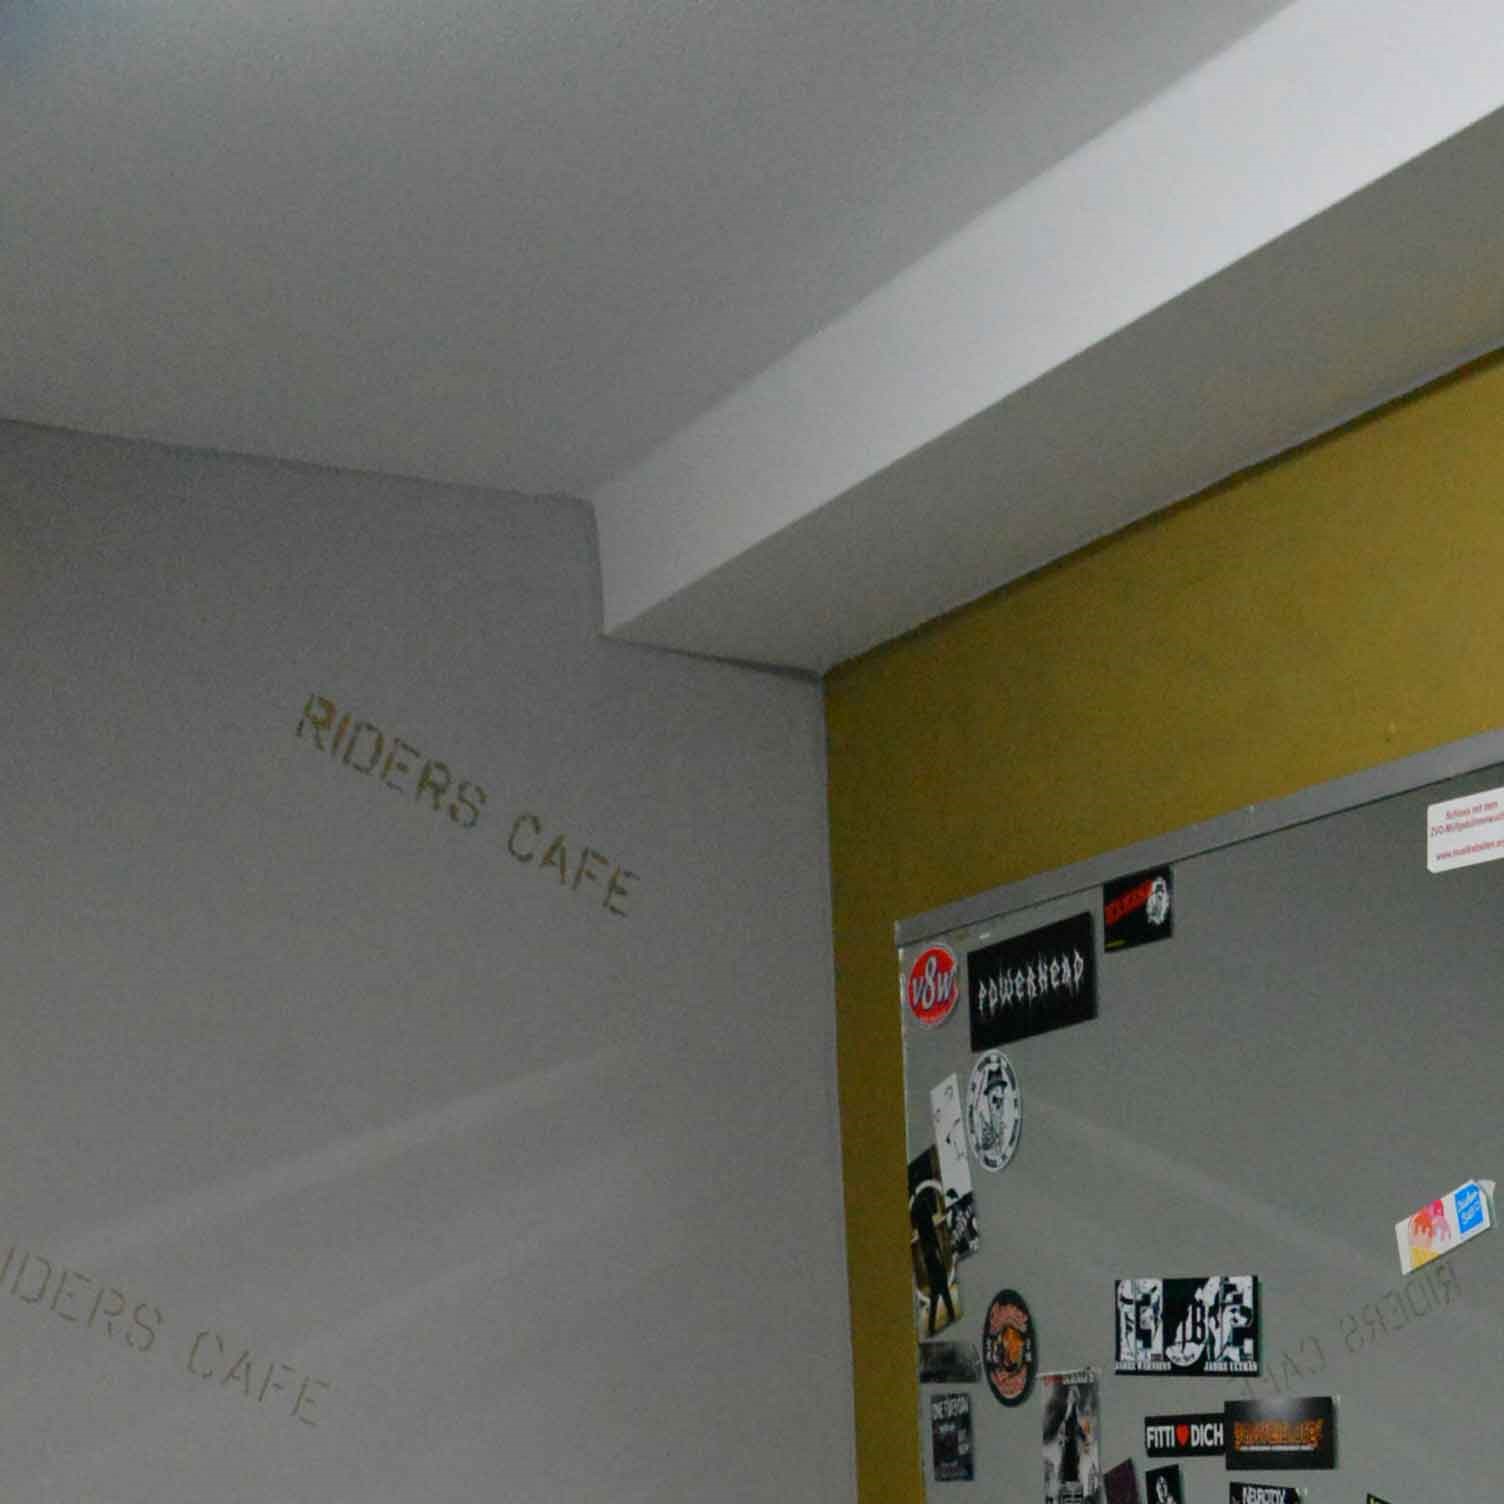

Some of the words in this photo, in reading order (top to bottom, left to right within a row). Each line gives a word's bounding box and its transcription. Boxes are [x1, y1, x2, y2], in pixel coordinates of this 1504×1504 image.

[294, 692, 488, 830] RIDERS
[505, 810, 642, 917] CAFE
[186, 1330, 332, 1427] CAFE
[1146, 1424, 1176, 1449] FITTI
[1190, 1422, 1225, 1448] DICH
